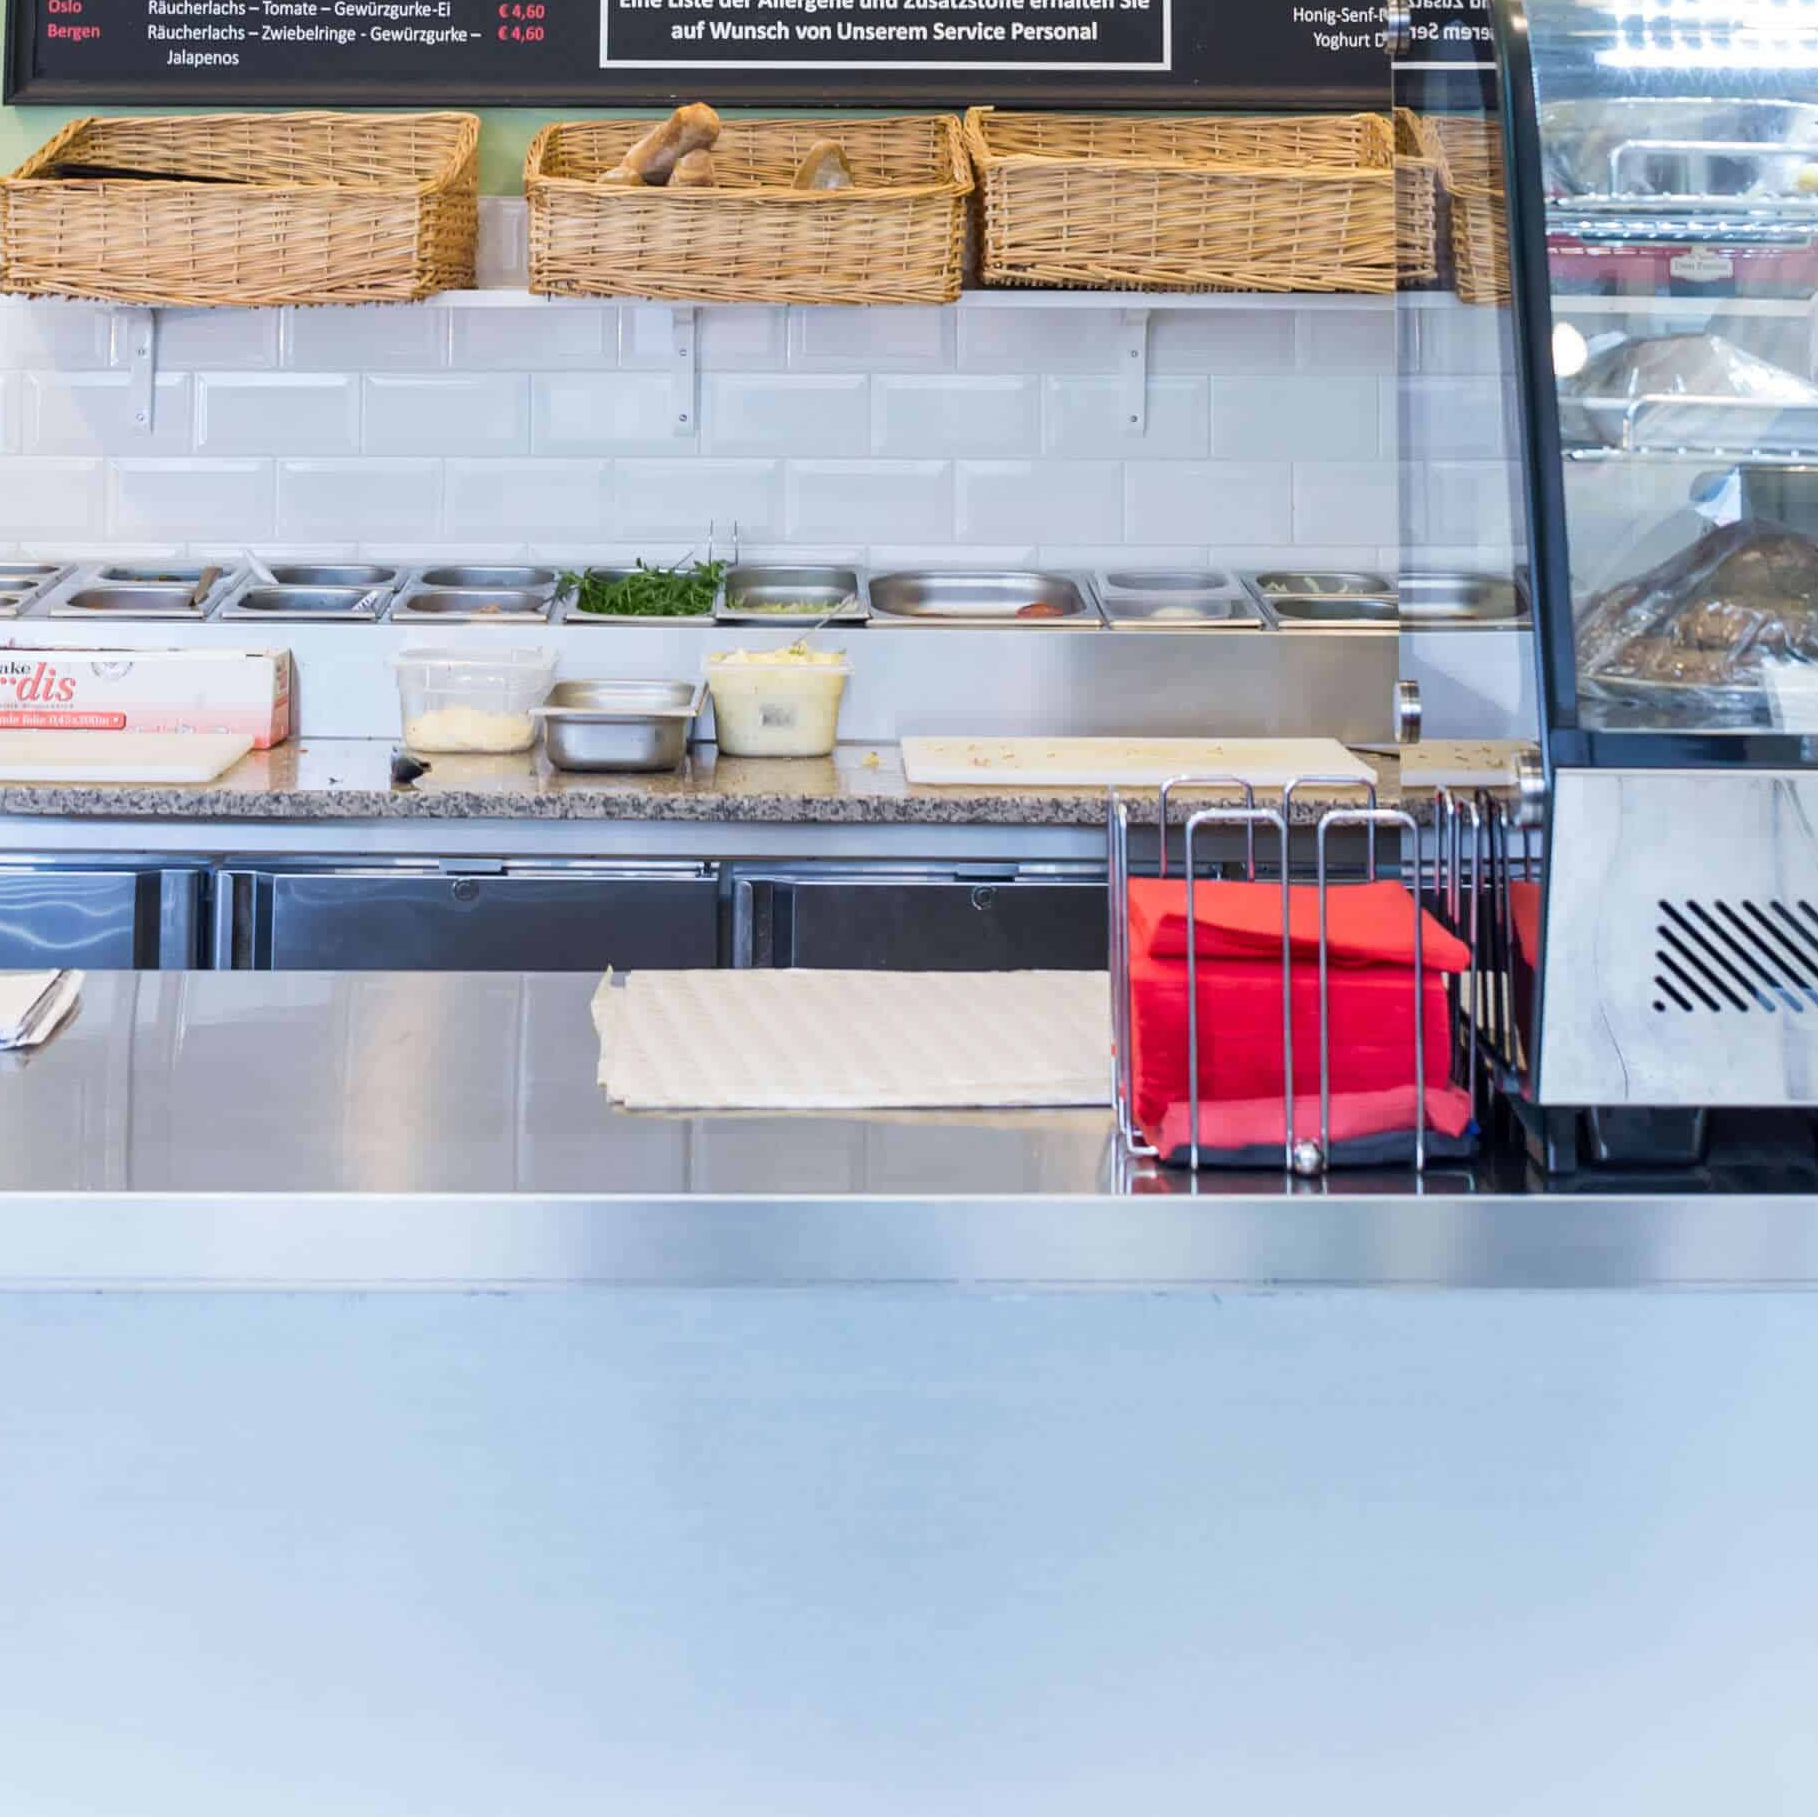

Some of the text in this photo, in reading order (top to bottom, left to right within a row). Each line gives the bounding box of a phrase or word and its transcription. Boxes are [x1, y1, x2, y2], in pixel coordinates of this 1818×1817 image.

[47, 22, 101, 42] Bergen
[670, 20, 1098, 41] auf Wunsch von Unserem Service Personal
[1313, 31, 1371, 51] Yoghurt
[16, 661, 77, 702] dis
